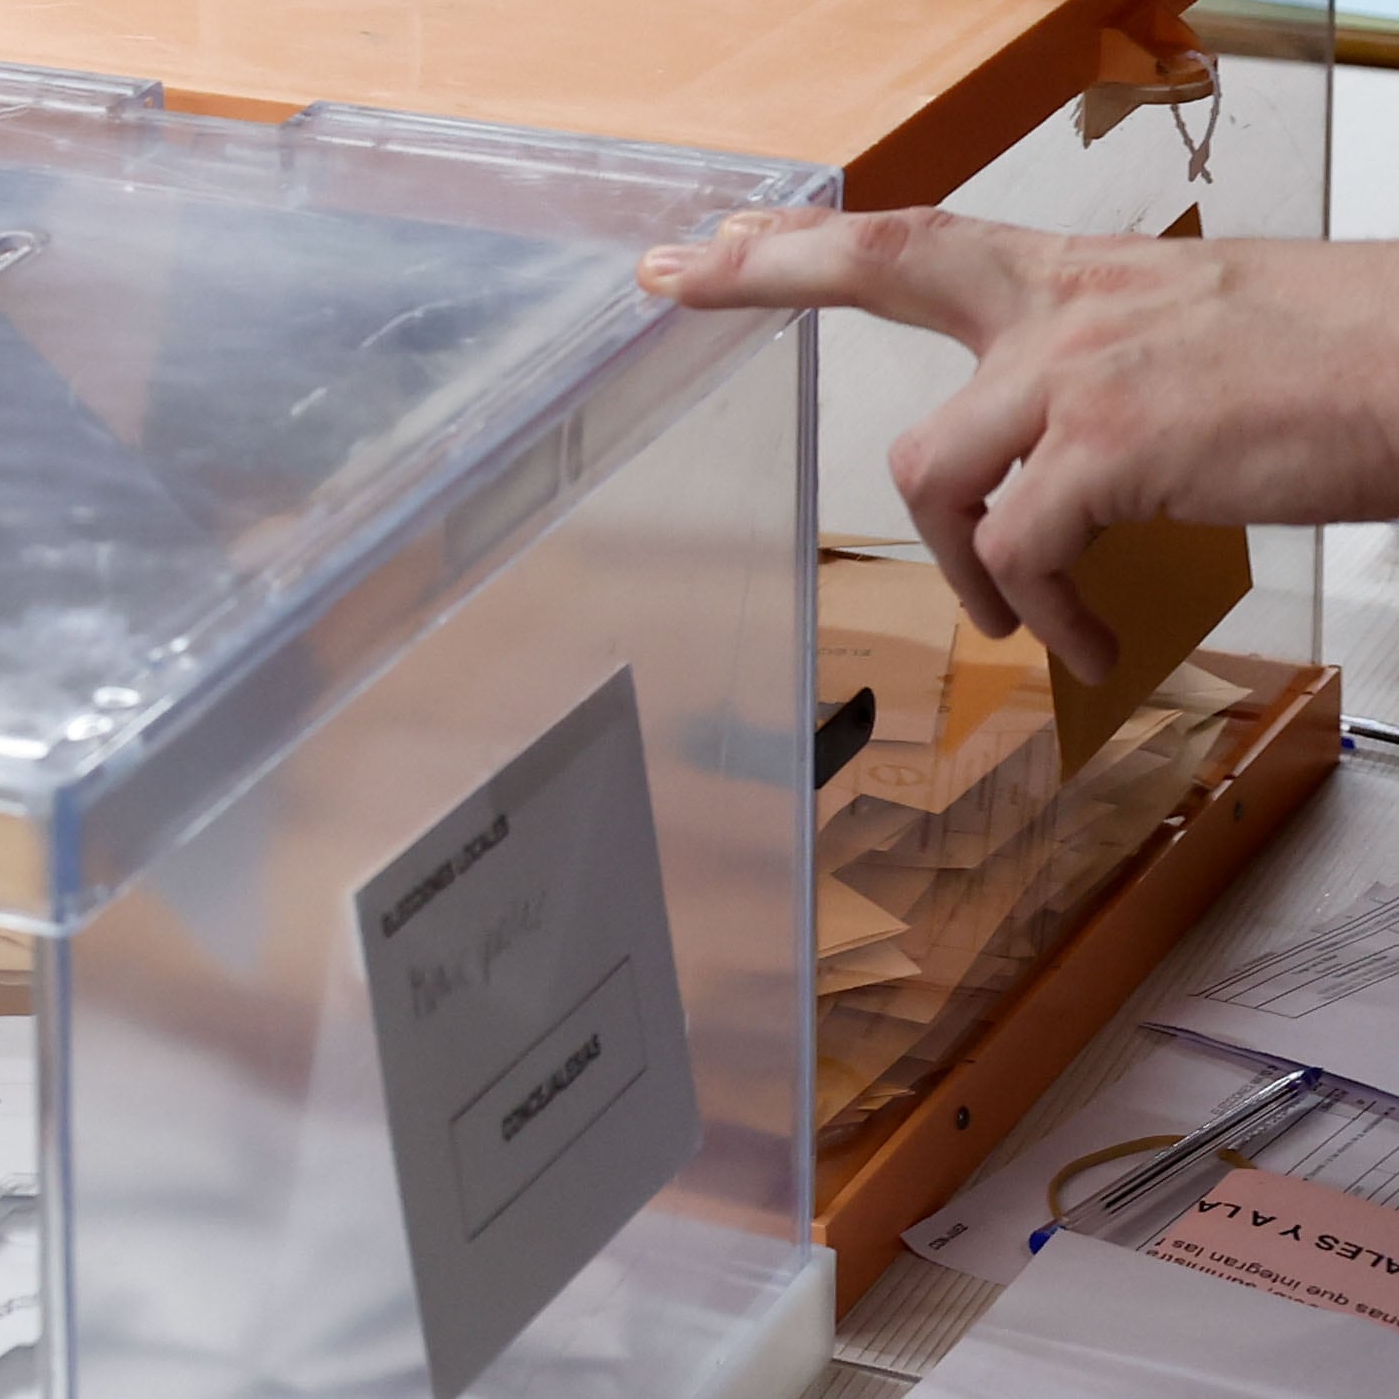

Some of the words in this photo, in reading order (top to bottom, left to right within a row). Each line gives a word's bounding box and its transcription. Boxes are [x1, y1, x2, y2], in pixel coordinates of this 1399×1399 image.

[1198, 1199, 1243, 1220] LA
[1250, 1209, 1278, 1228] A
[1278, 1223, 1302, 1242] Y
[1171, 1238, 1205, 1258] las
[1315, 1233, 1399, 1276] ALES
[1209, 1250, 1302, 1291] integran
[1306, 1284, 1350, 1307] que
